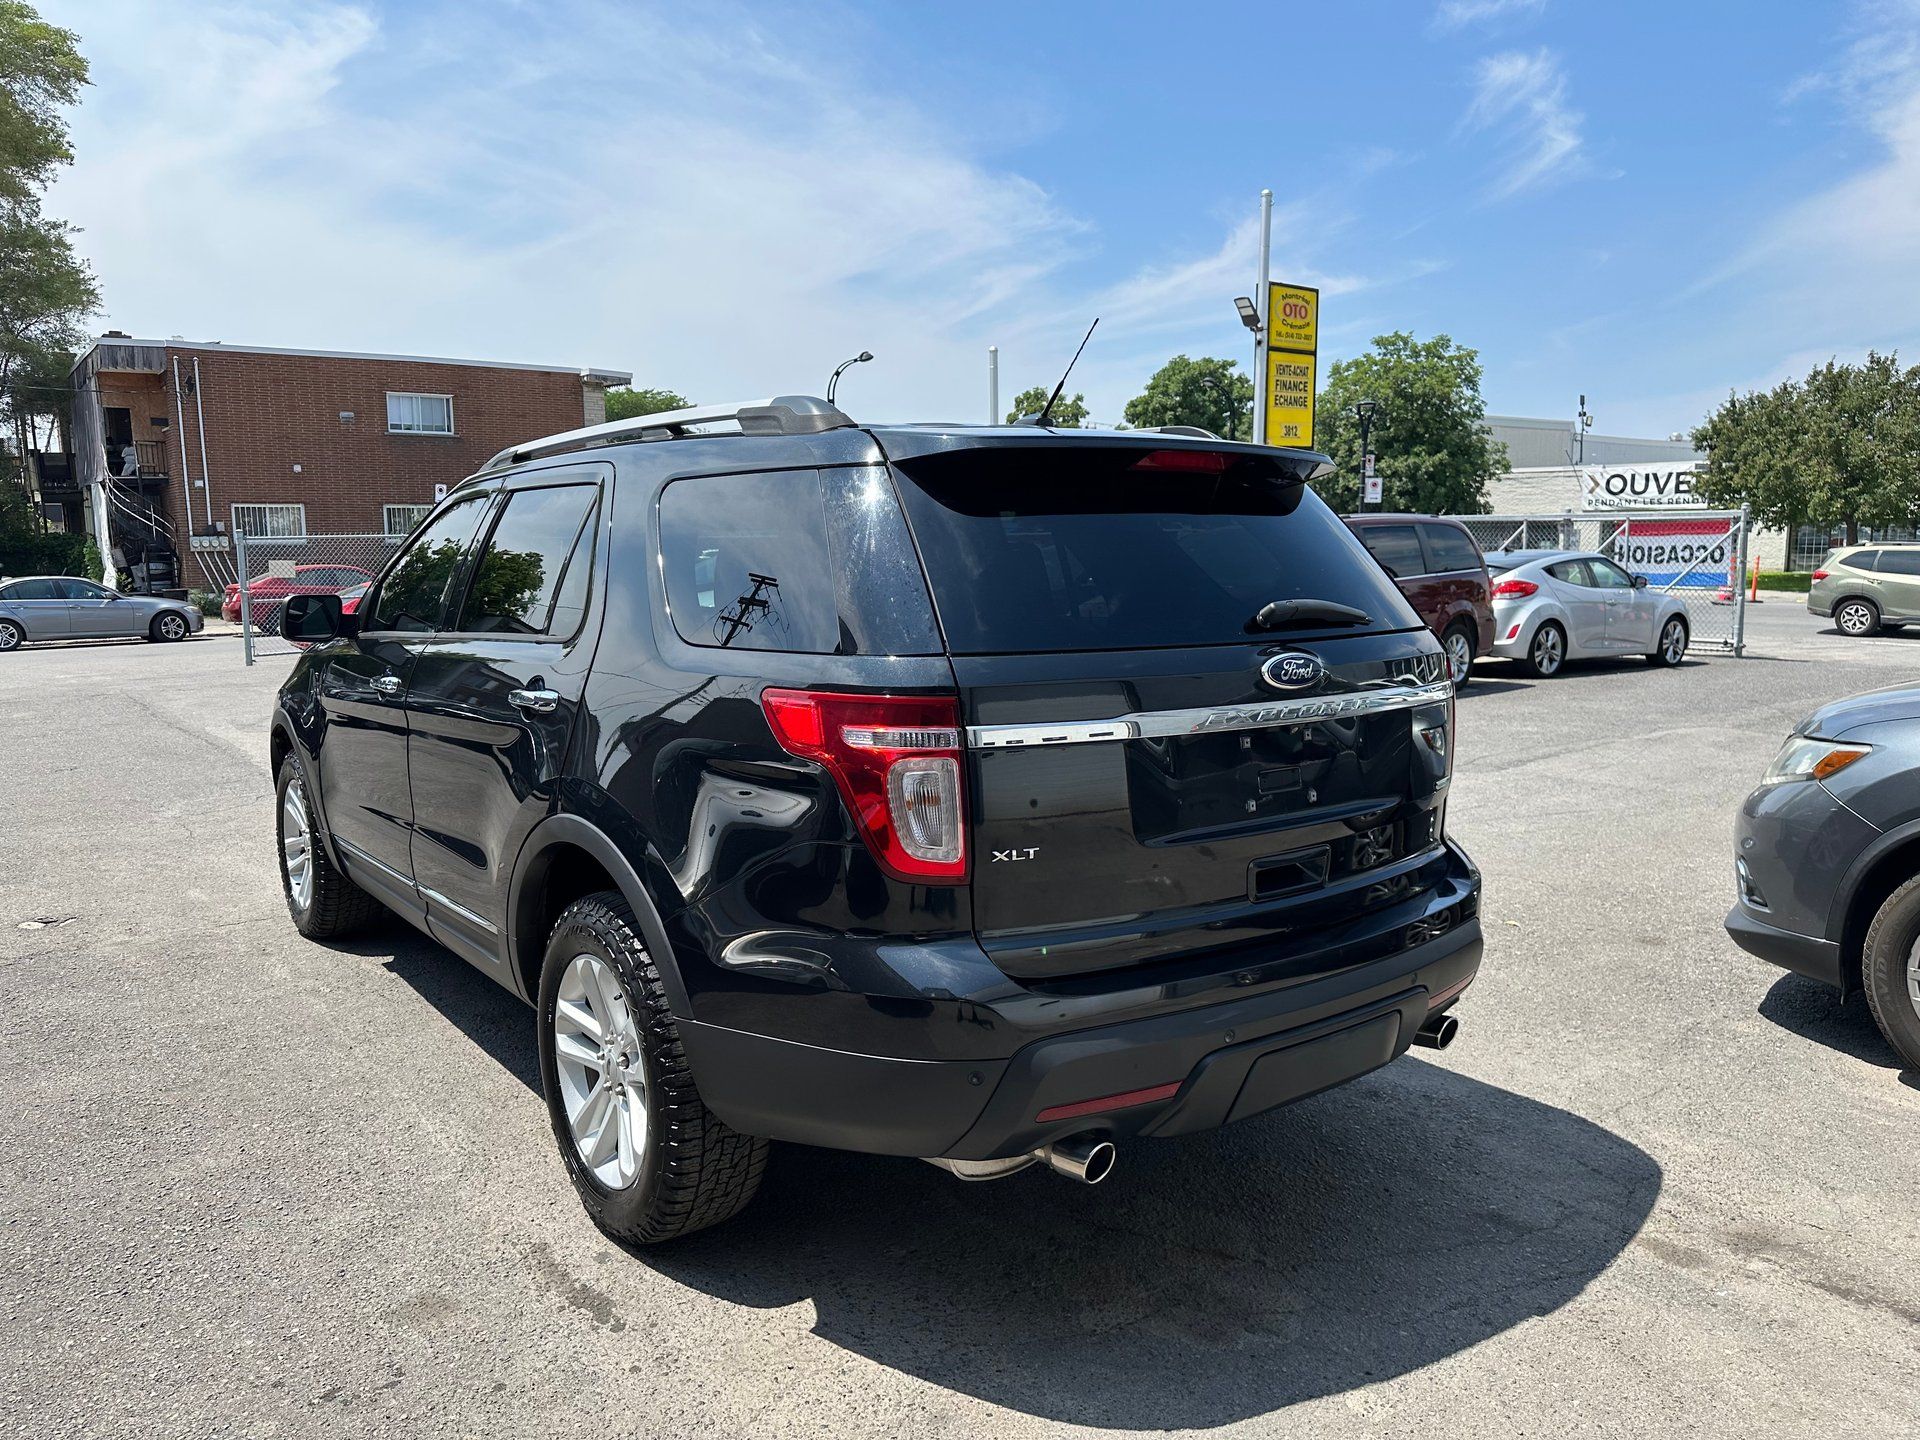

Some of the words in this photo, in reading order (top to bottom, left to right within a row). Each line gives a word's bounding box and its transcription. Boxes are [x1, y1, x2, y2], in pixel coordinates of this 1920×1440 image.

[1283, 303, 1308, 319] OTO
[1275, 364, 1309, 377] VENTE-ACHAT
[1275, 379, 1308, 392] FINANCE
[1274, 395, 1308, 407] ECHANGE
[1587, 498, 1638, 508] PENDANT
[1281, 659, 1314, 680] Ford
[1205, 696, 1371, 725] EXPLORER
[991, 847, 1040, 863] XLT
